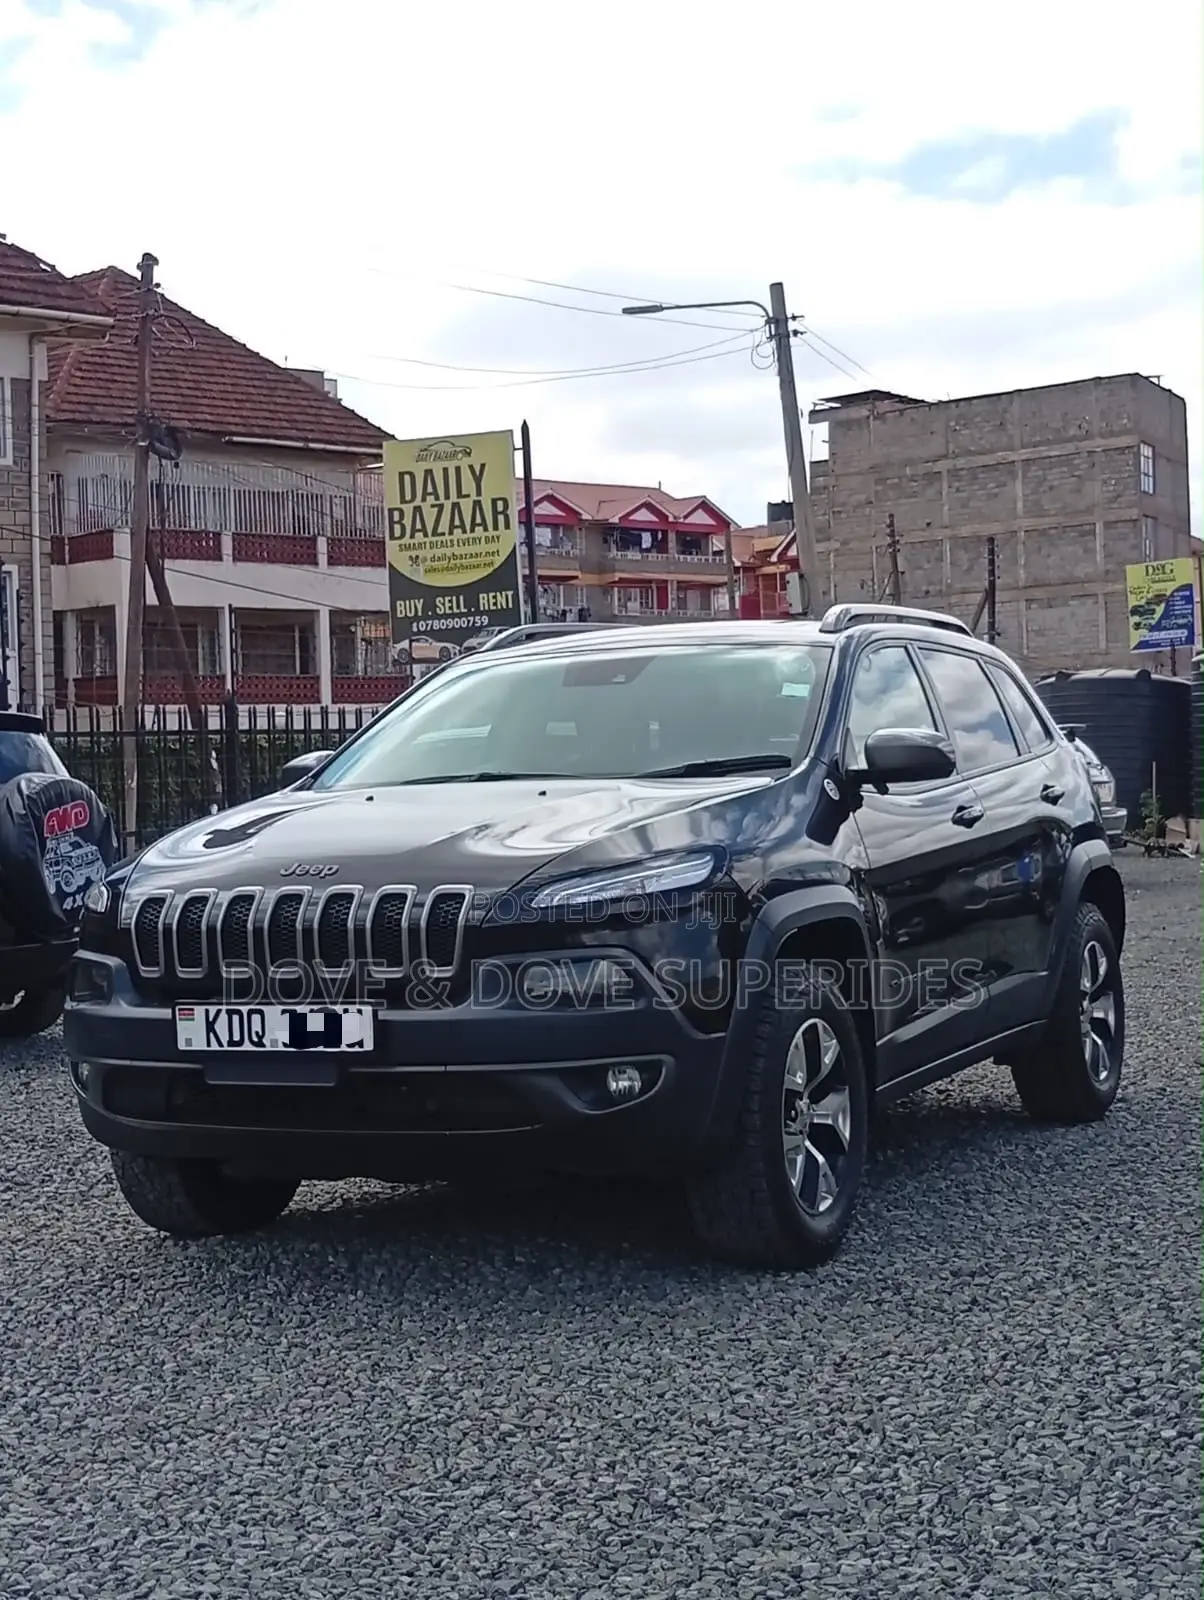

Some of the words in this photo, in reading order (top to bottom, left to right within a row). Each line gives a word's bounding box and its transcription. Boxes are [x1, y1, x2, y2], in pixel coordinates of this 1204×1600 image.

[398, 463, 487, 504] DAILY
[387, 497, 511, 541] BAZAAR
[398, 541, 427, 552] SMART
[429, 539, 455, 550] DEALS
[457, 536, 482, 547] EVERY
[484, 534, 501, 545] DAY
[430, 549, 500, 565] dailybazaar.net
[396, 598, 424, 618] BUY
[435, 595, 468, 615] SELL
[479, 591, 514, 611] RENT
[418, 615, 489, 632] 0780900759
[280, 863, 339, 879] Jeep
[62, 892, 85, 911] 4X
[205, 1008, 266, 1049] KDQ
